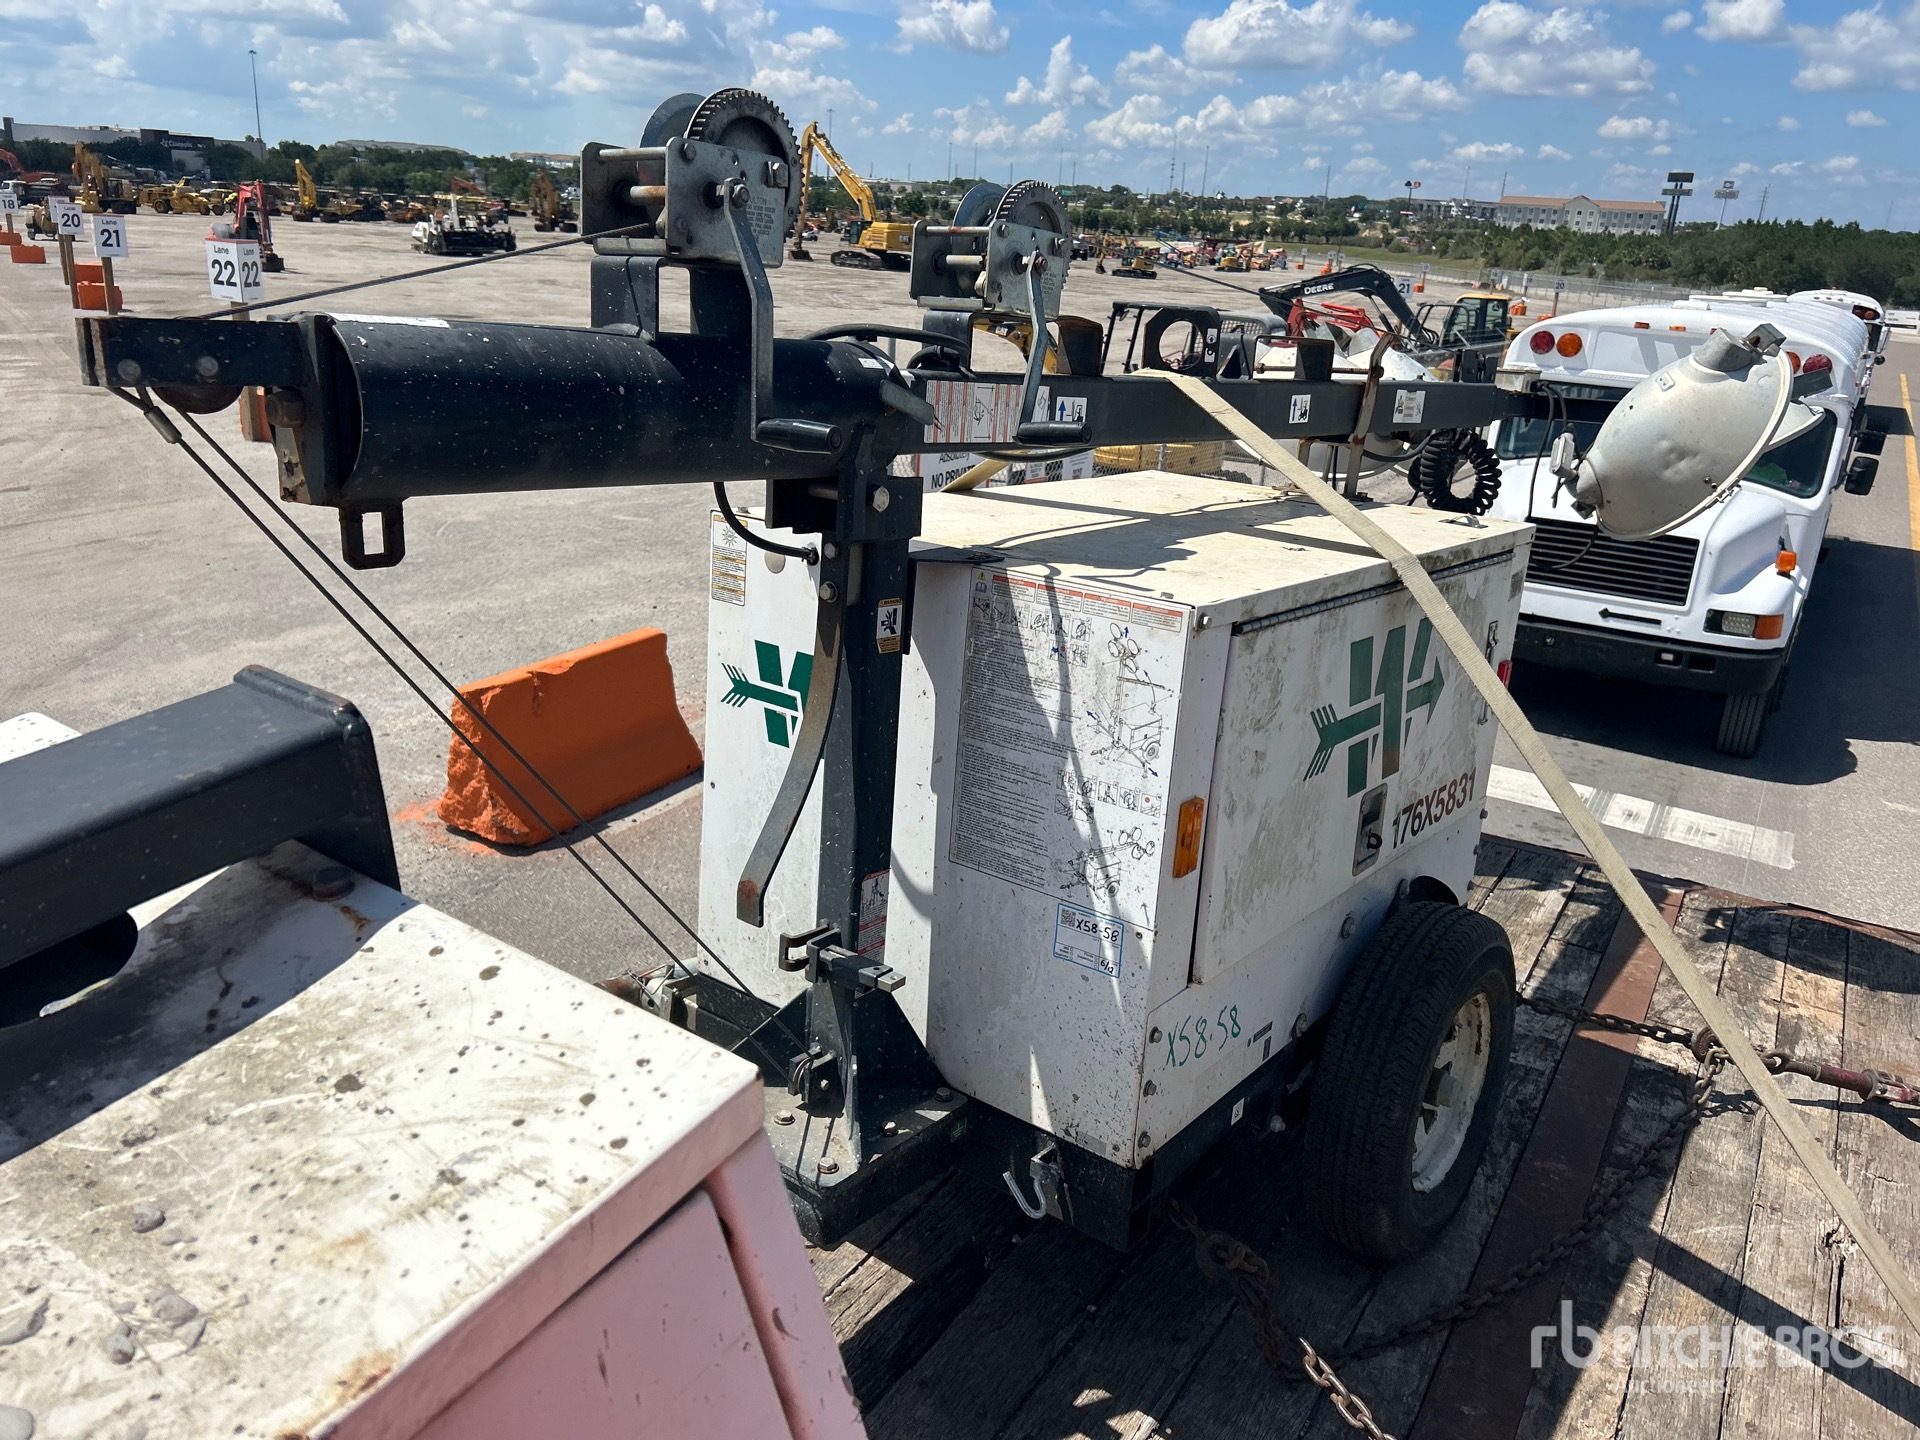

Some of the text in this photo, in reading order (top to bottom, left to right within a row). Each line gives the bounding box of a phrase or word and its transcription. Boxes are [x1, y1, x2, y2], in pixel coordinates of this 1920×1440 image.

[2, 199, 15, 209] 18
[61, 213, 80, 228] 20
[100, 229, 120, 247] 21
[213, 245, 229, 254] Lane
[211, 259, 237, 287] 22
[242, 261, 260, 288] 22
[1304, 283, 1334, 295] DEERE
[1398, 283, 1410, 294] 21
[931, 473, 944, 489] NO
[1392, 767, 1476, 849] 176X5831
